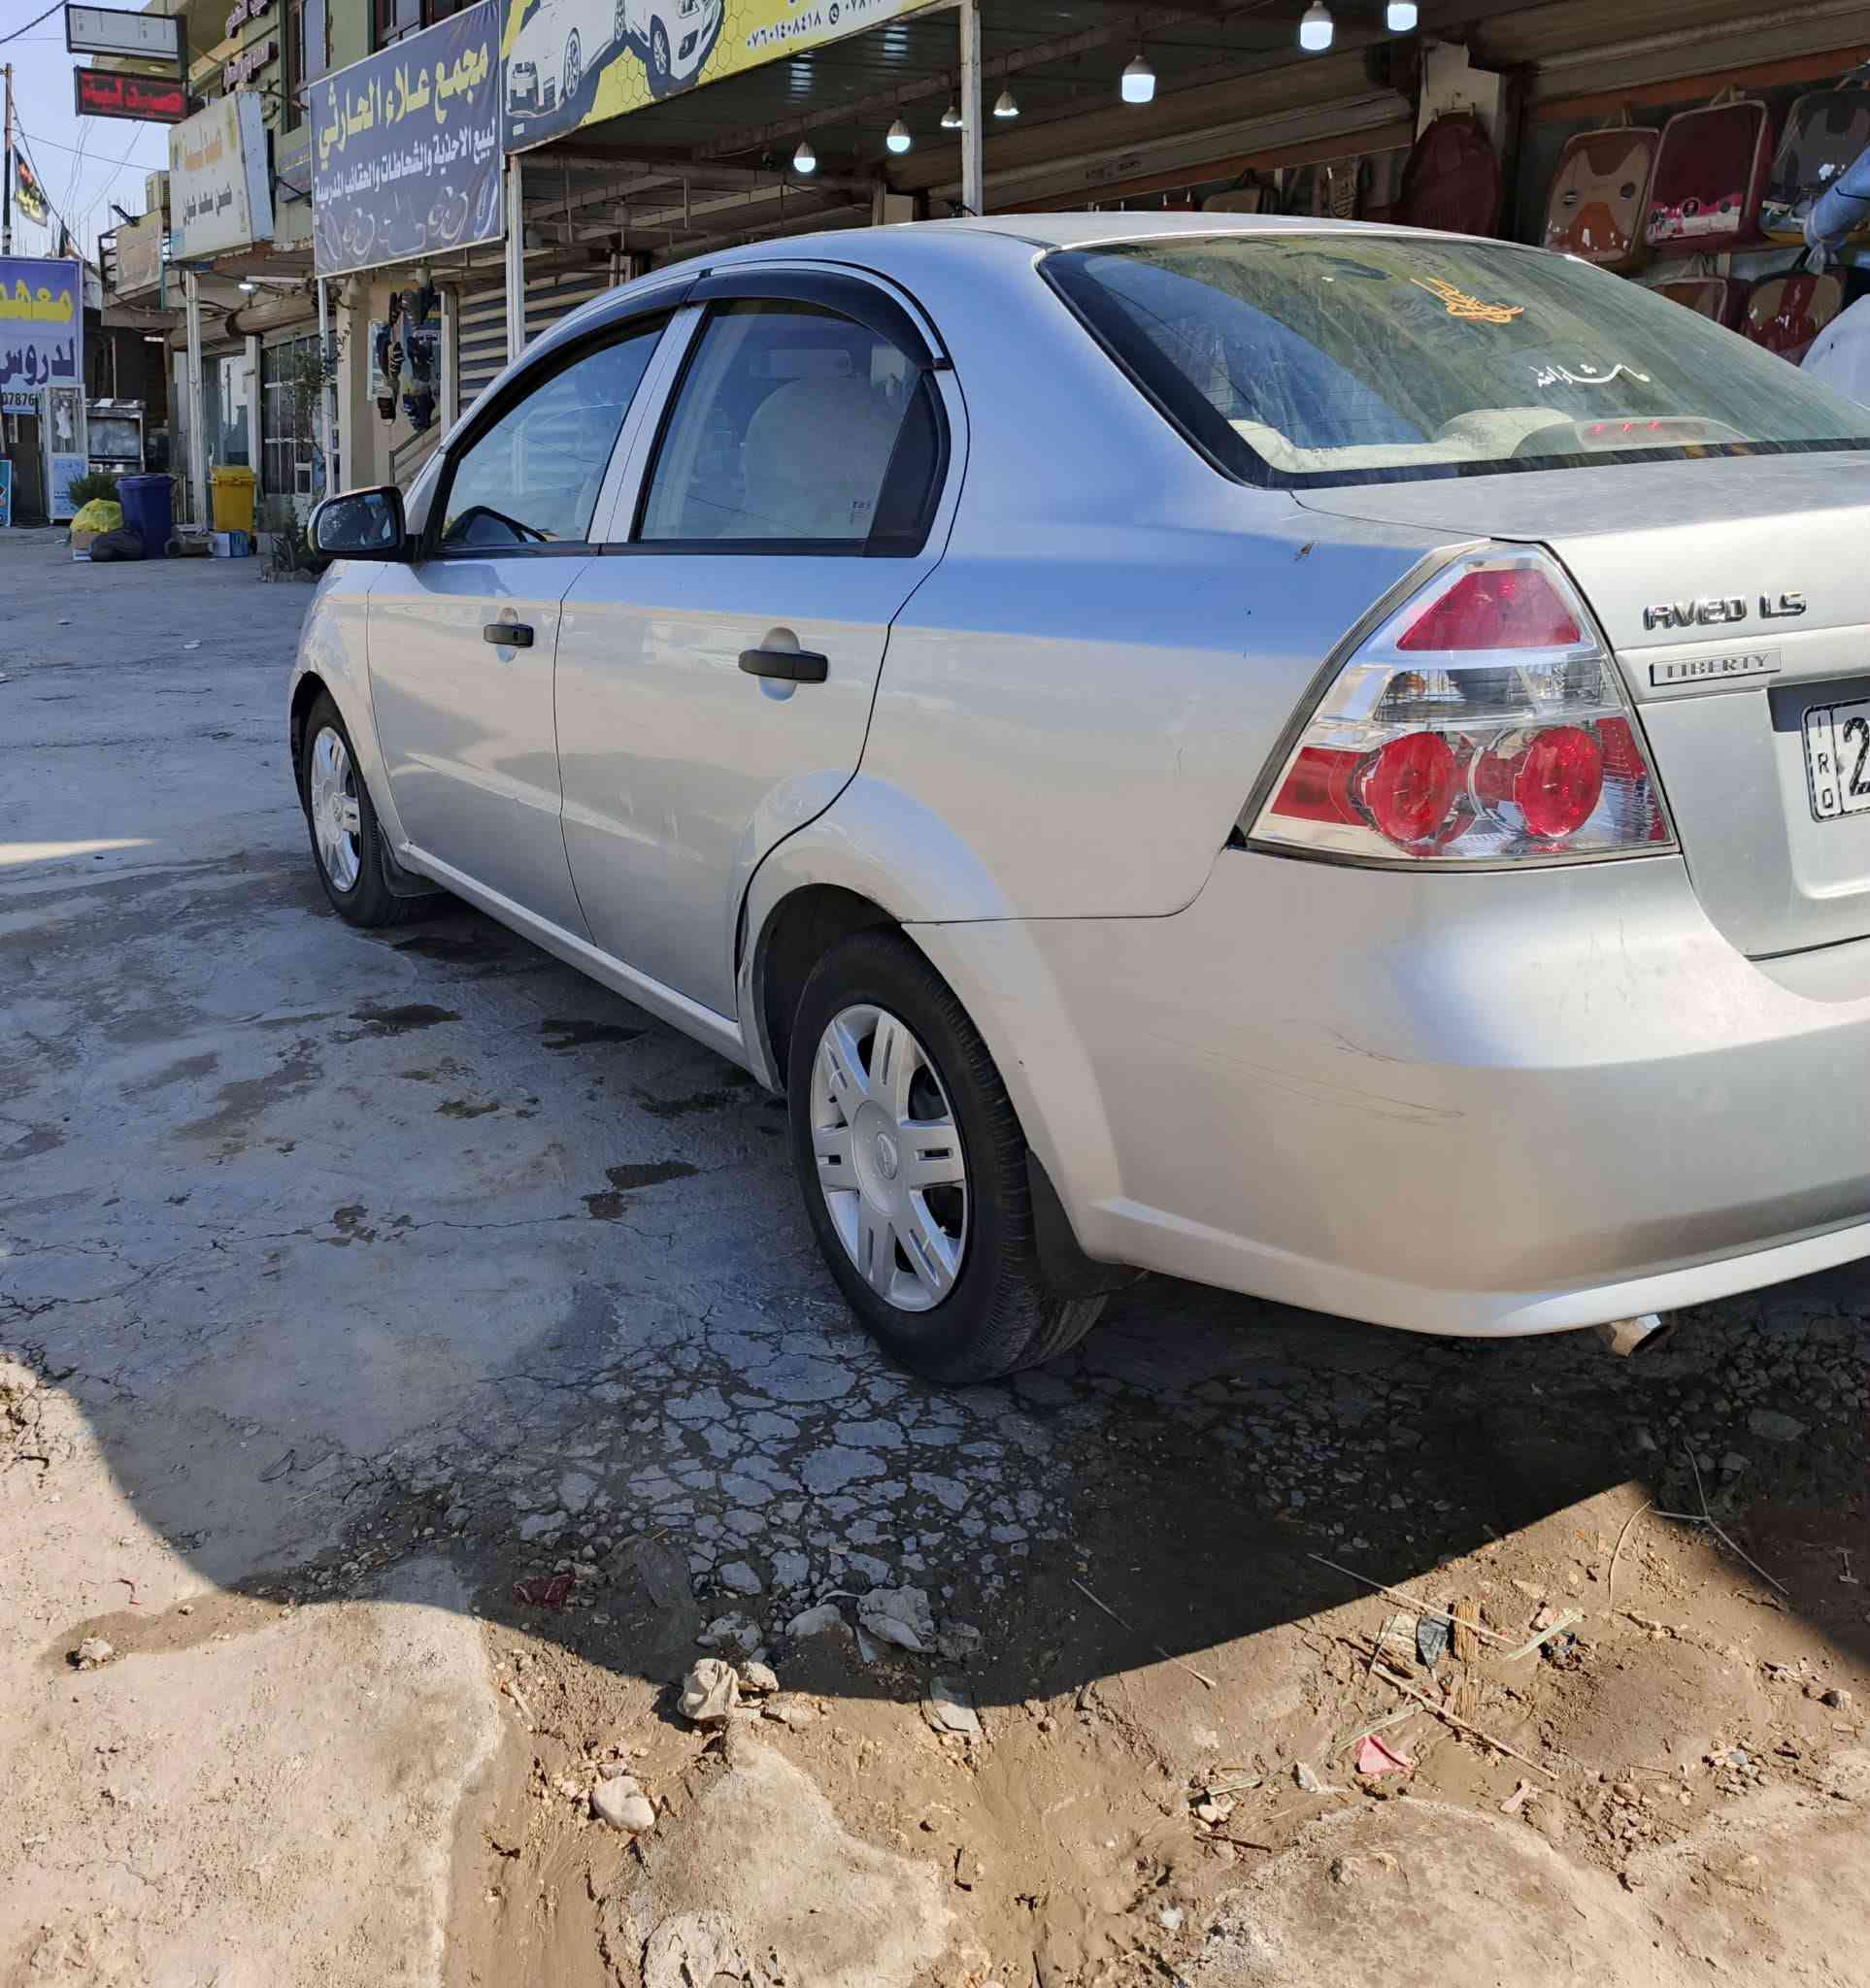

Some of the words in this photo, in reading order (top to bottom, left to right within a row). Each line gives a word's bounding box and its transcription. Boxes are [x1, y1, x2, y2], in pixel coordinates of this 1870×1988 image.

[385, 61, 430, 128] علاء
[434, 42, 489, 124] مجمع
[1643, 597, 1748, 631] AVEO
[1759, 590, 1807, 619] LS
[1666, 653, 1770, 679] LIBERTY
